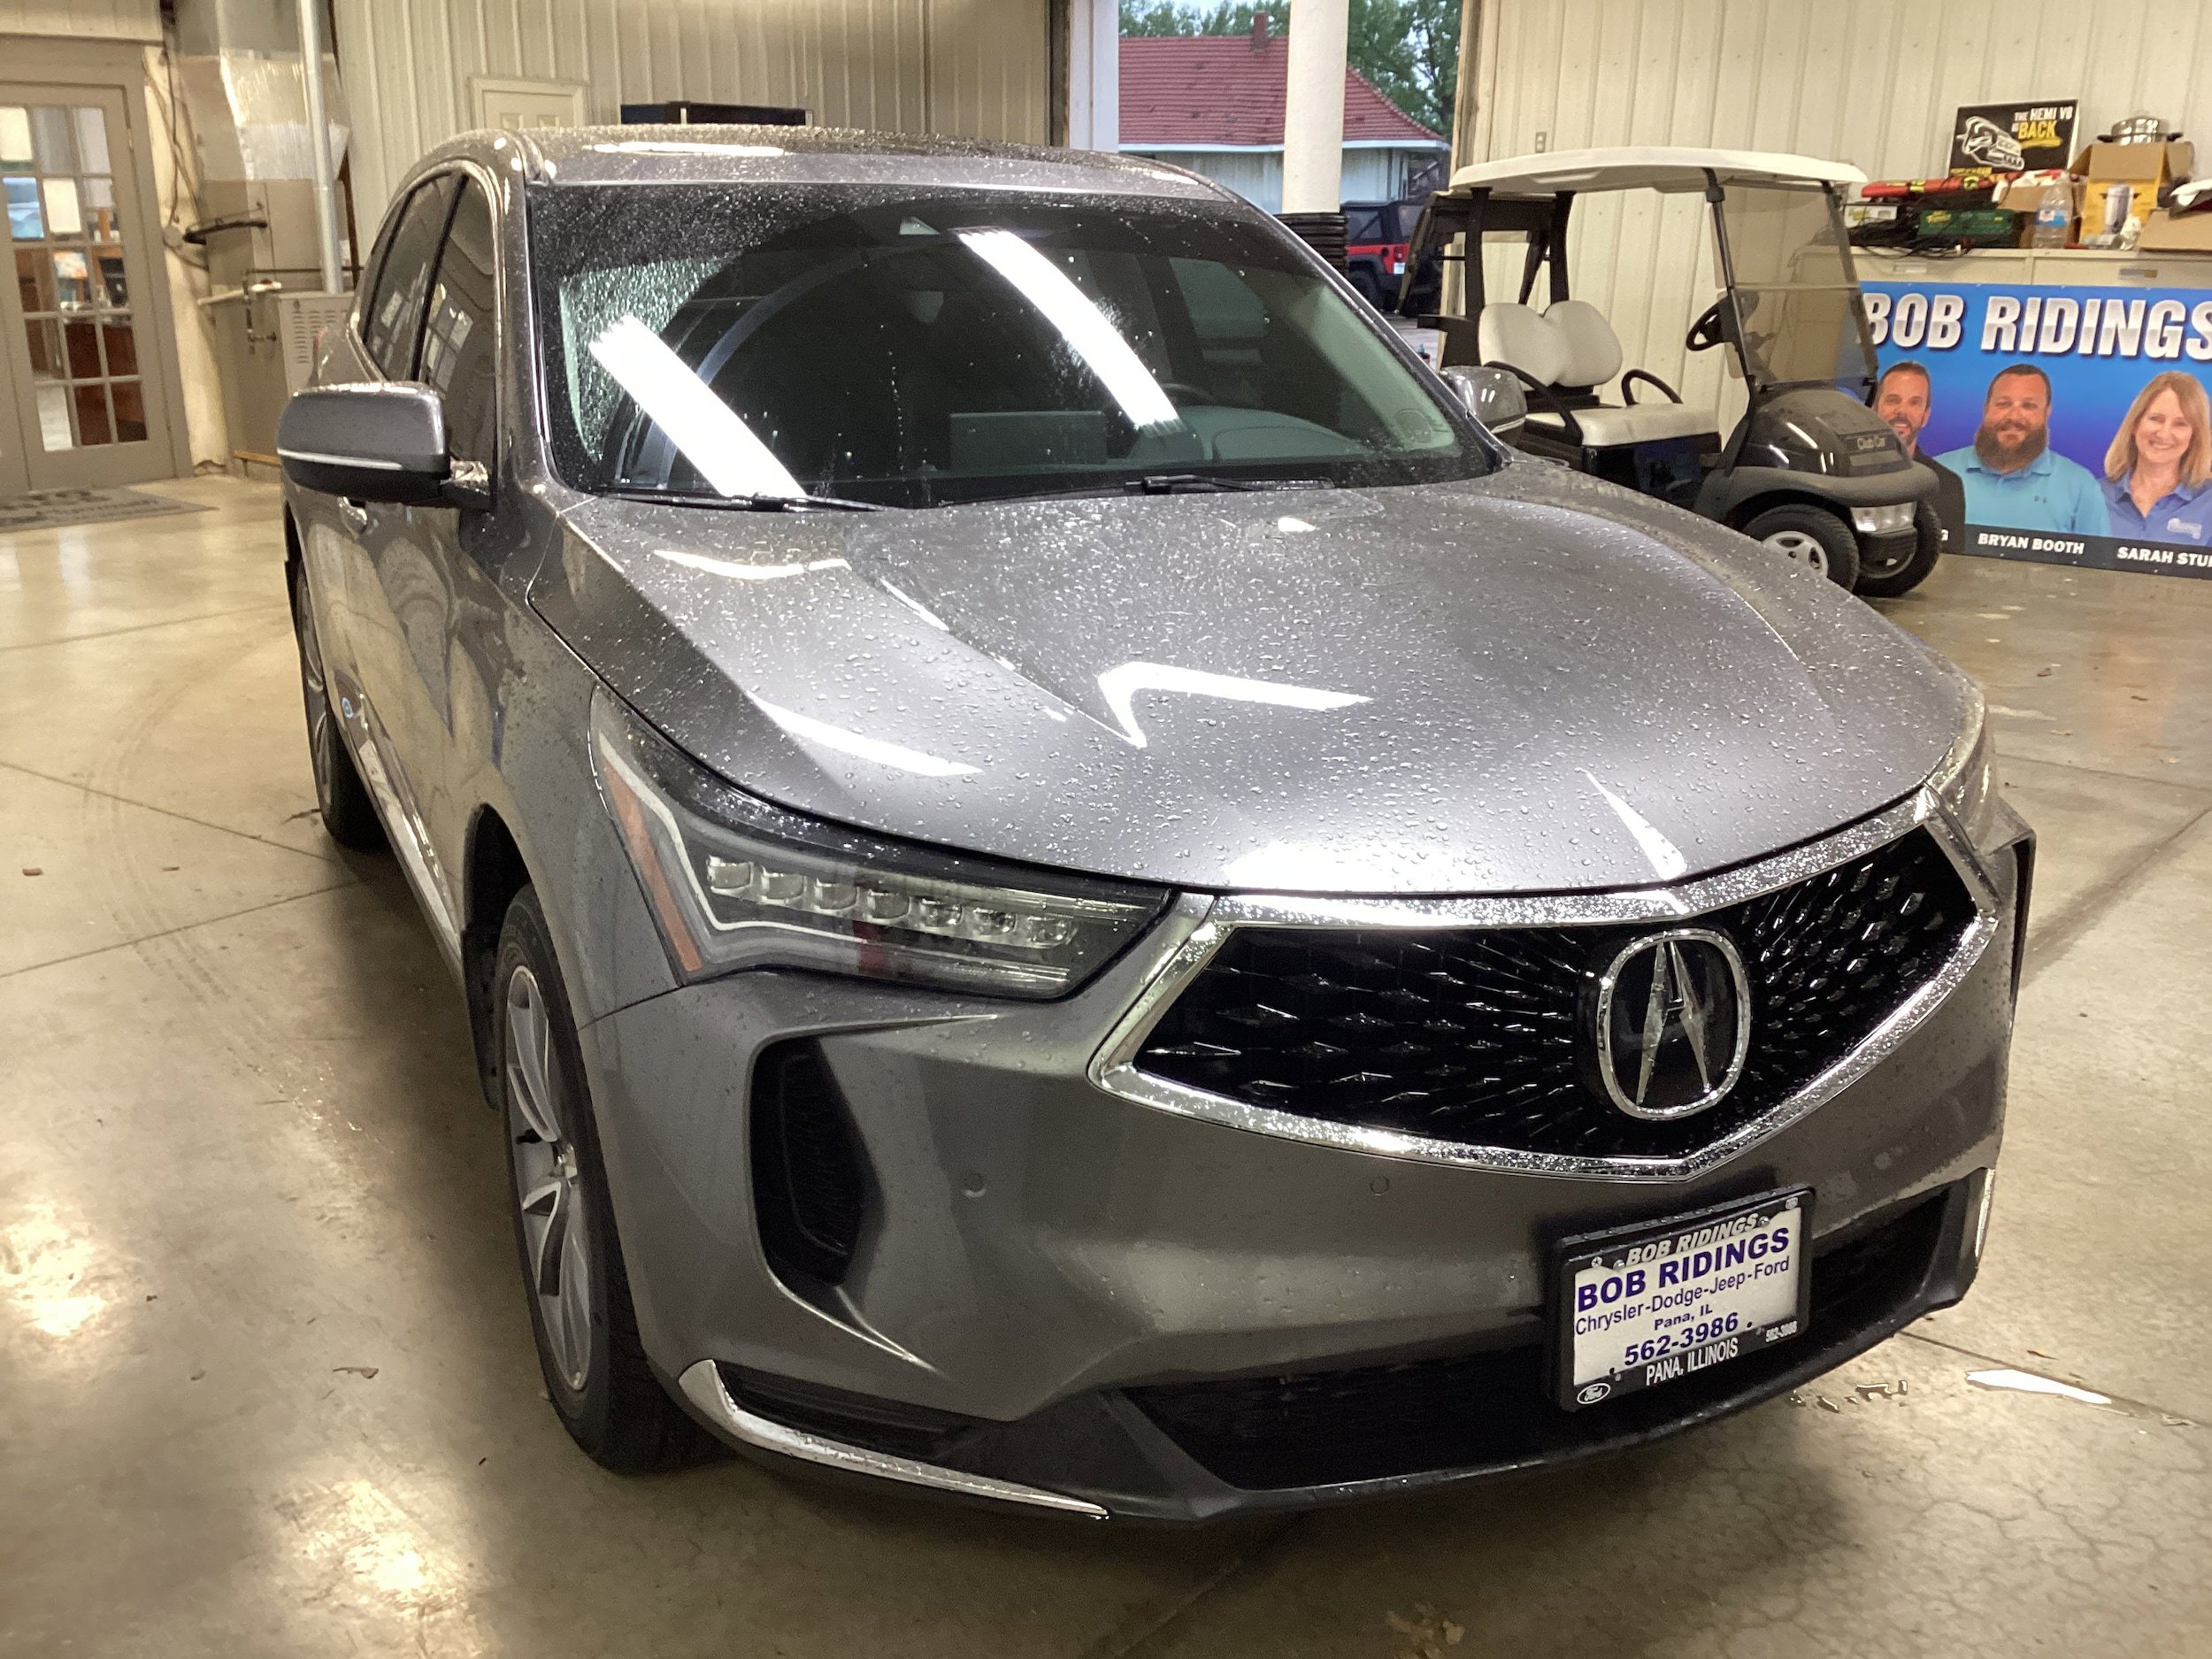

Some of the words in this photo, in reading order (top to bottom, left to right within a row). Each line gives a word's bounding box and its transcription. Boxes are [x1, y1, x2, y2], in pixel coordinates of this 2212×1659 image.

[2018, 120, 2057, 139] BACK
[2030, 107, 2057, 121] HEMI
[2060, 106, 2073, 119] V8
[1863, 293, 1964, 349] BOB
[1980, 296, 2212, 360] RIDINGS
[1978, 533, 2029, 549] BRYAN
[2032, 536, 2085, 555] BOOTH
[2117, 547, 2174, 564] SARAH
[1625, 1240, 1672, 1266] BOB
[1675, 1212, 1759, 1255] RIDINGS
[1578, 1270, 1646, 1312] BOB
[1658, 1227, 1789, 1288] RIDINGS
[1576, 1256, 1789, 1335] Chrysler-Dodge-Jeep-Ford
[1654, 1313, 1694, 1331] Pana,
[1700, 1304, 1713, 1317] IL
[1624, 1312, 1739, 1366] 562-3986
[1646, 1359, 1683, 1386] PANA,
[1686, 1337, 1739, 1371] ILLINOIS
